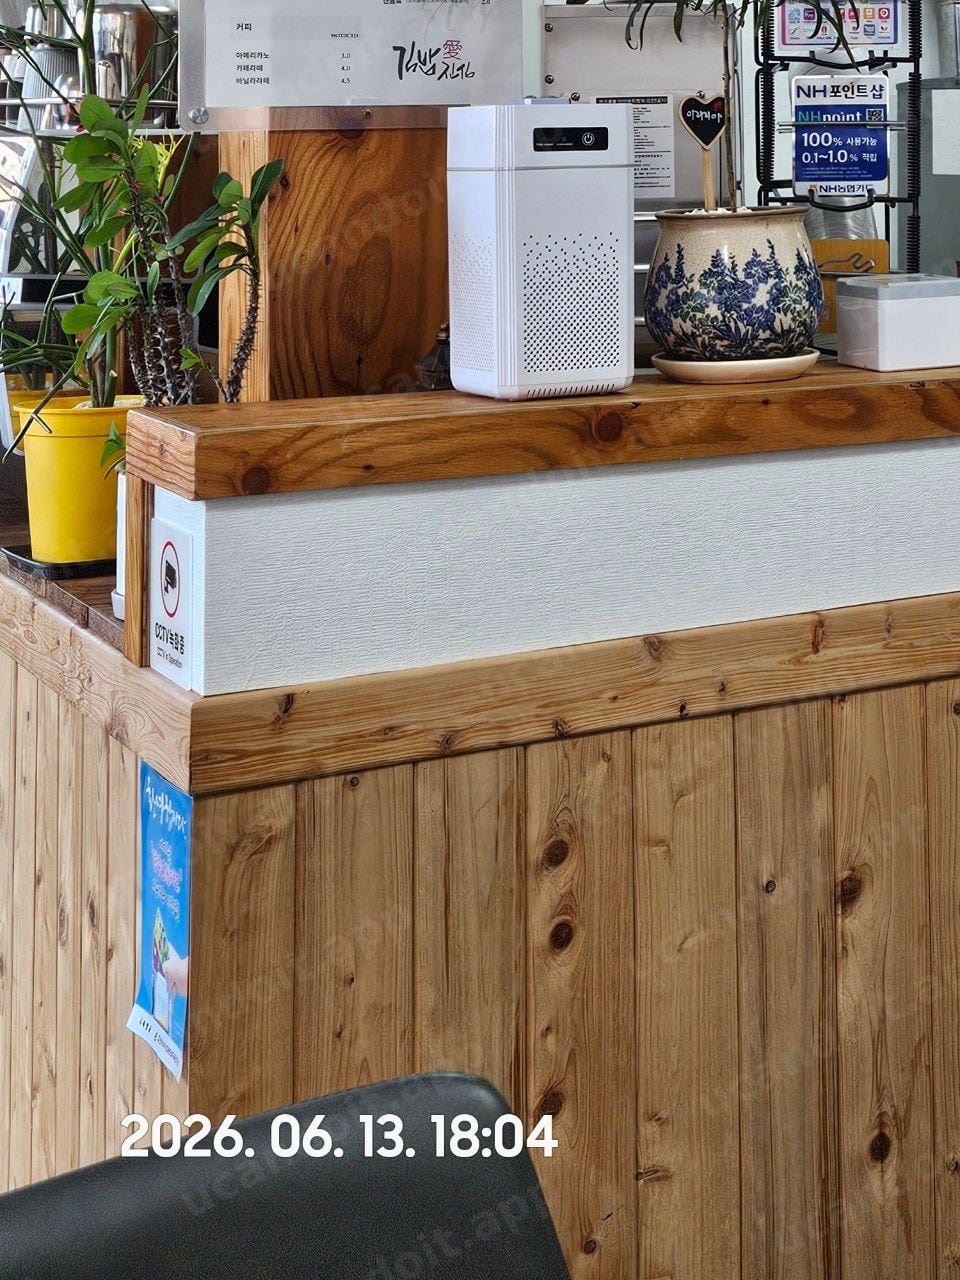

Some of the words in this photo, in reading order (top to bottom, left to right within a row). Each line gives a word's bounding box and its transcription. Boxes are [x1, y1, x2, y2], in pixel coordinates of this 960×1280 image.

[236, 22, 253, 32] 커피
[235, 51, 271, 60] 아메리카노
[443, 39, 463, 61] 愛
[392, 40, 442, 81] 김밥
[829, 81, 869, 99] 포인트
[802, 132, 843, 147] 100%
[846, 137, 878, 147] 사용가능
[861, 153, 878, 163] 적립
